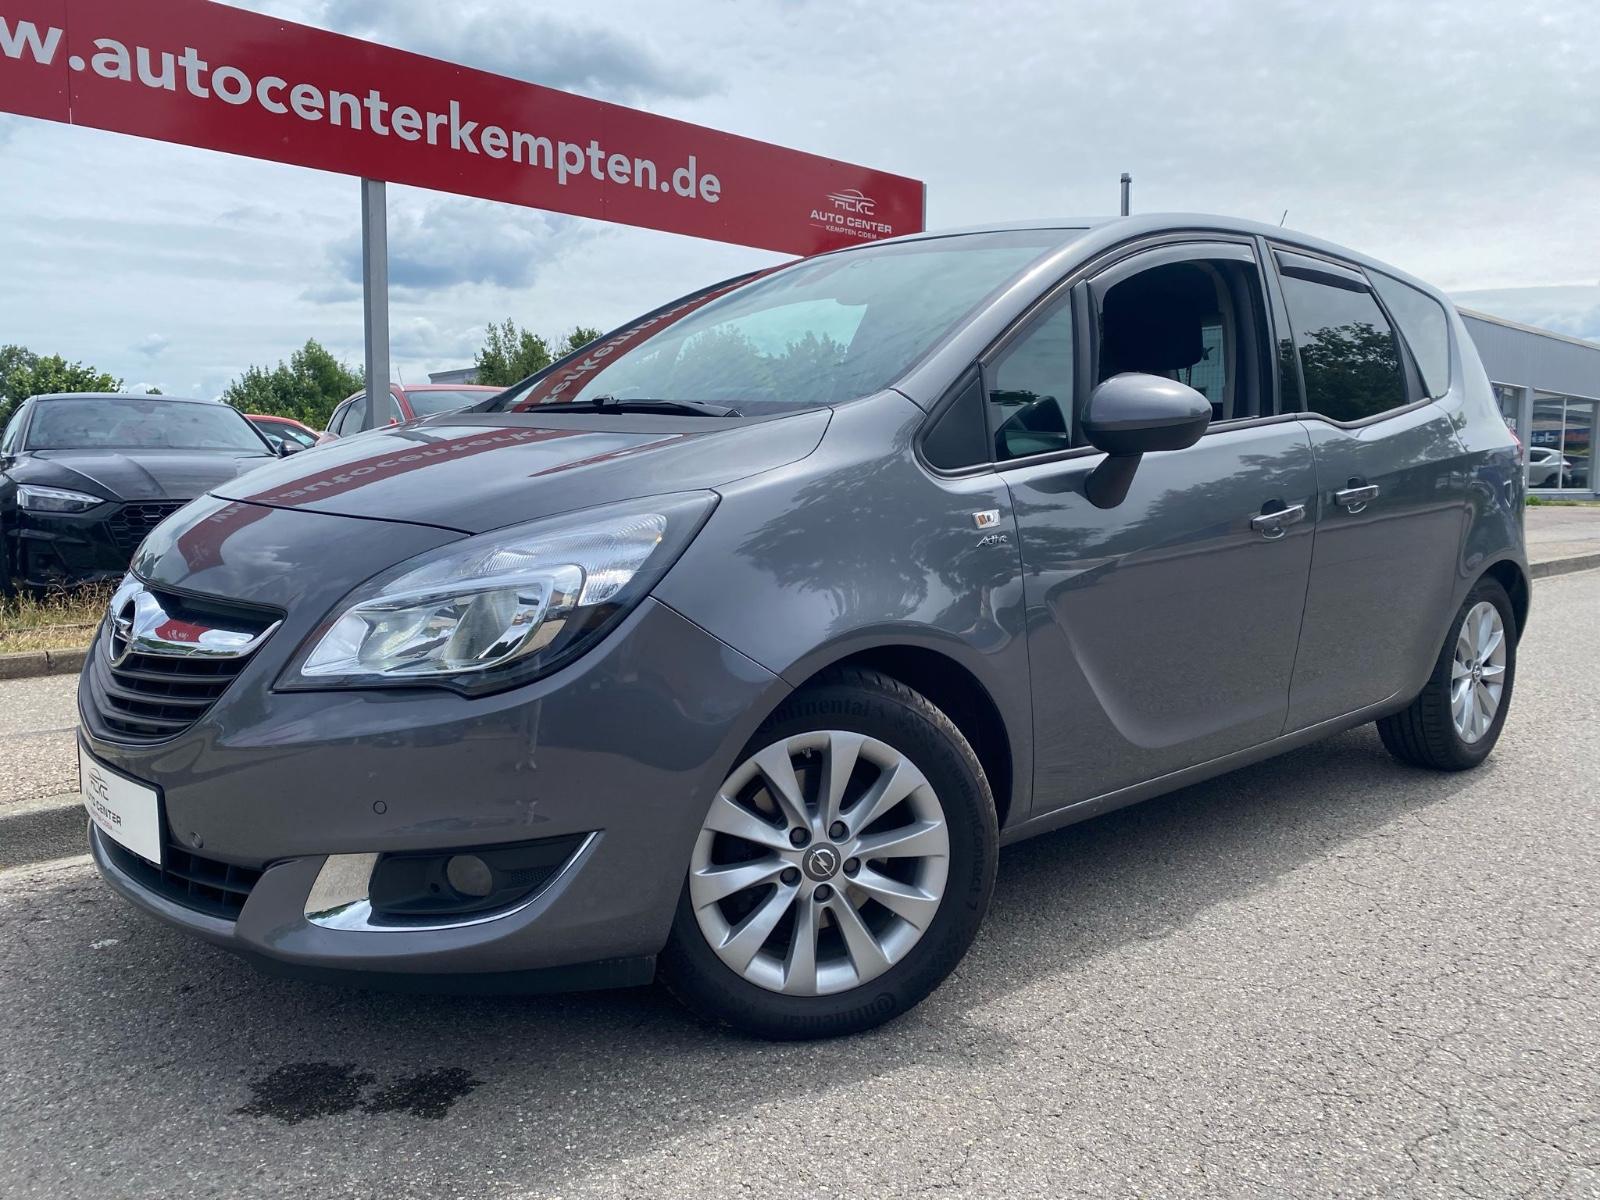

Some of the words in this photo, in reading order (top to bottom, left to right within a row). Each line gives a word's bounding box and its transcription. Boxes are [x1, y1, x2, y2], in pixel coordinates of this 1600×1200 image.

[810, 209, 844, 224] AUTO
[846, 216, 893, 234] CENTER
[825, 225, 857, 236] KEMPTEN
[96, 801, 122, 827] CENTER
